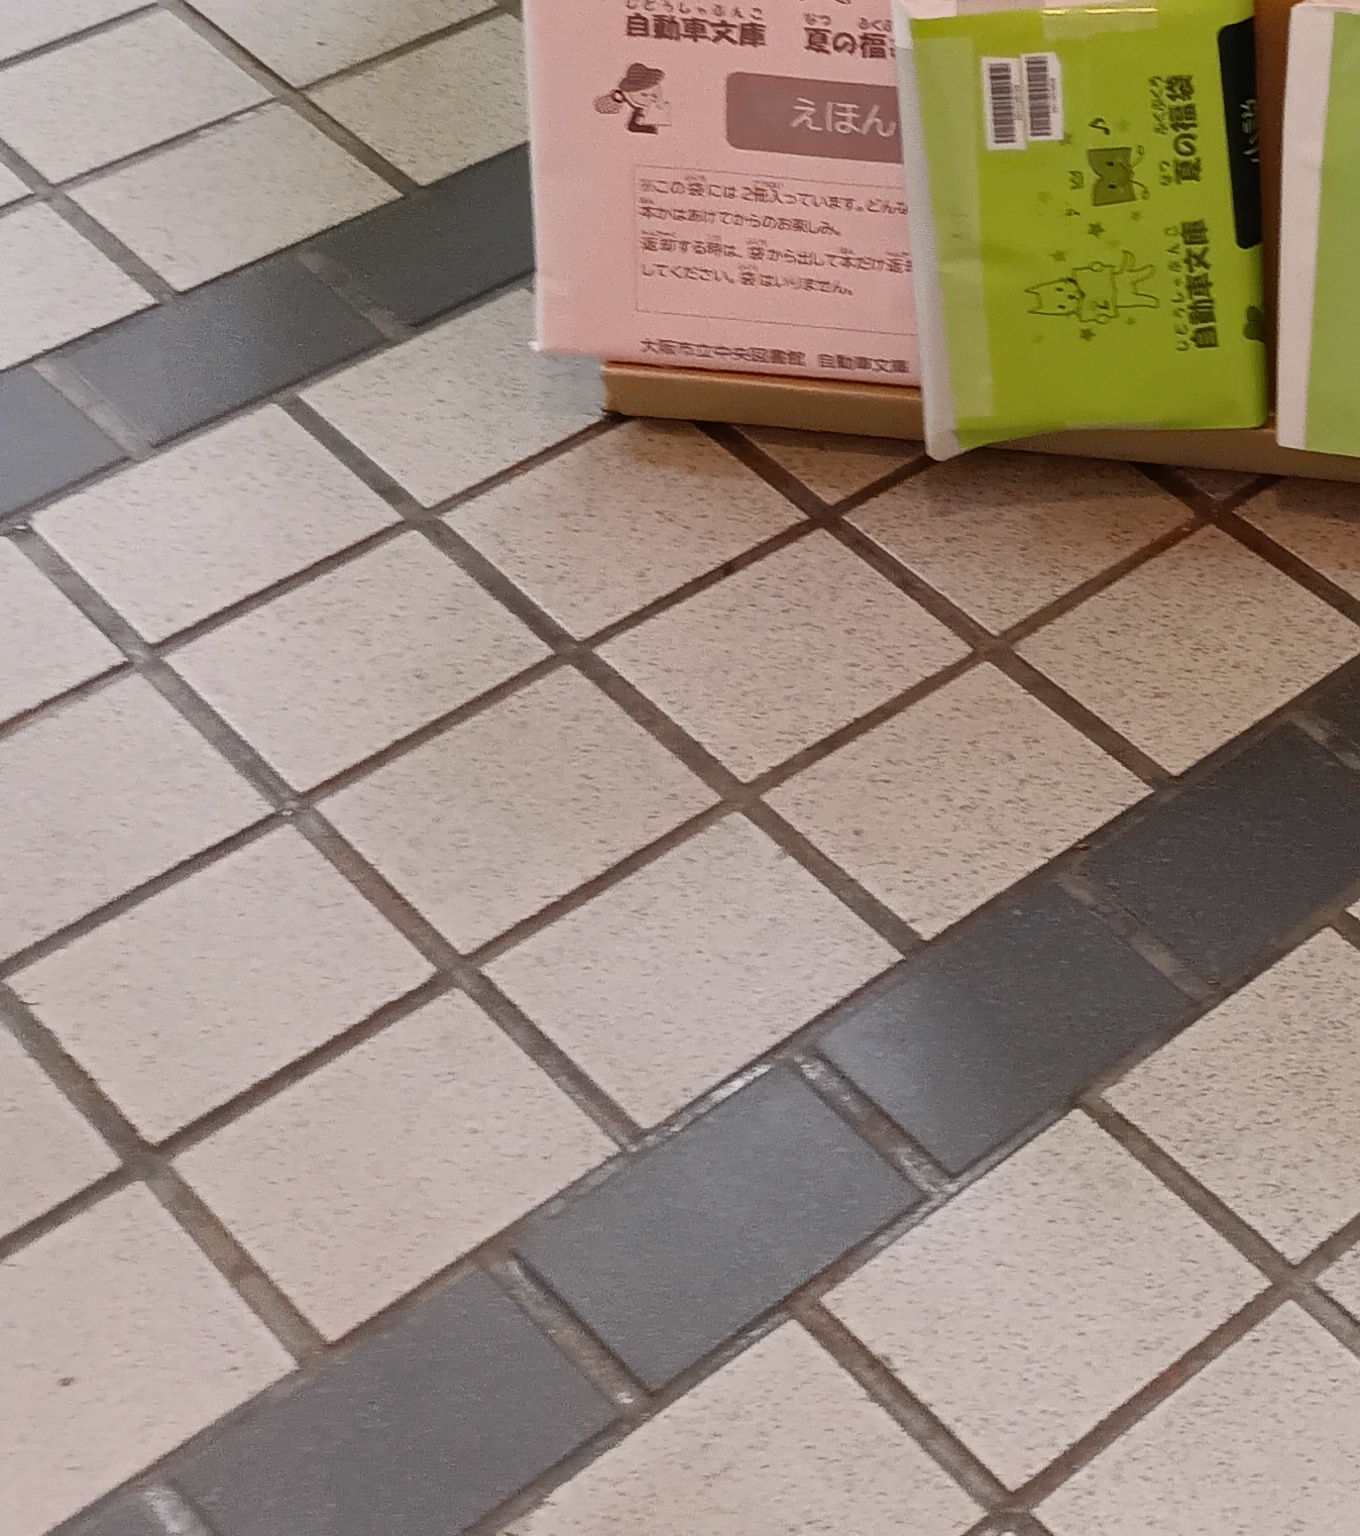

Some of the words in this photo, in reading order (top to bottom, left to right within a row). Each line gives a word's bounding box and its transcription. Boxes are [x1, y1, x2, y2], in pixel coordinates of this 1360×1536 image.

[626, 13, 766, 46] 自動車文庫
[804, 27, 896, 60] 夏の福
[790, 97, 897, 137] えほん
